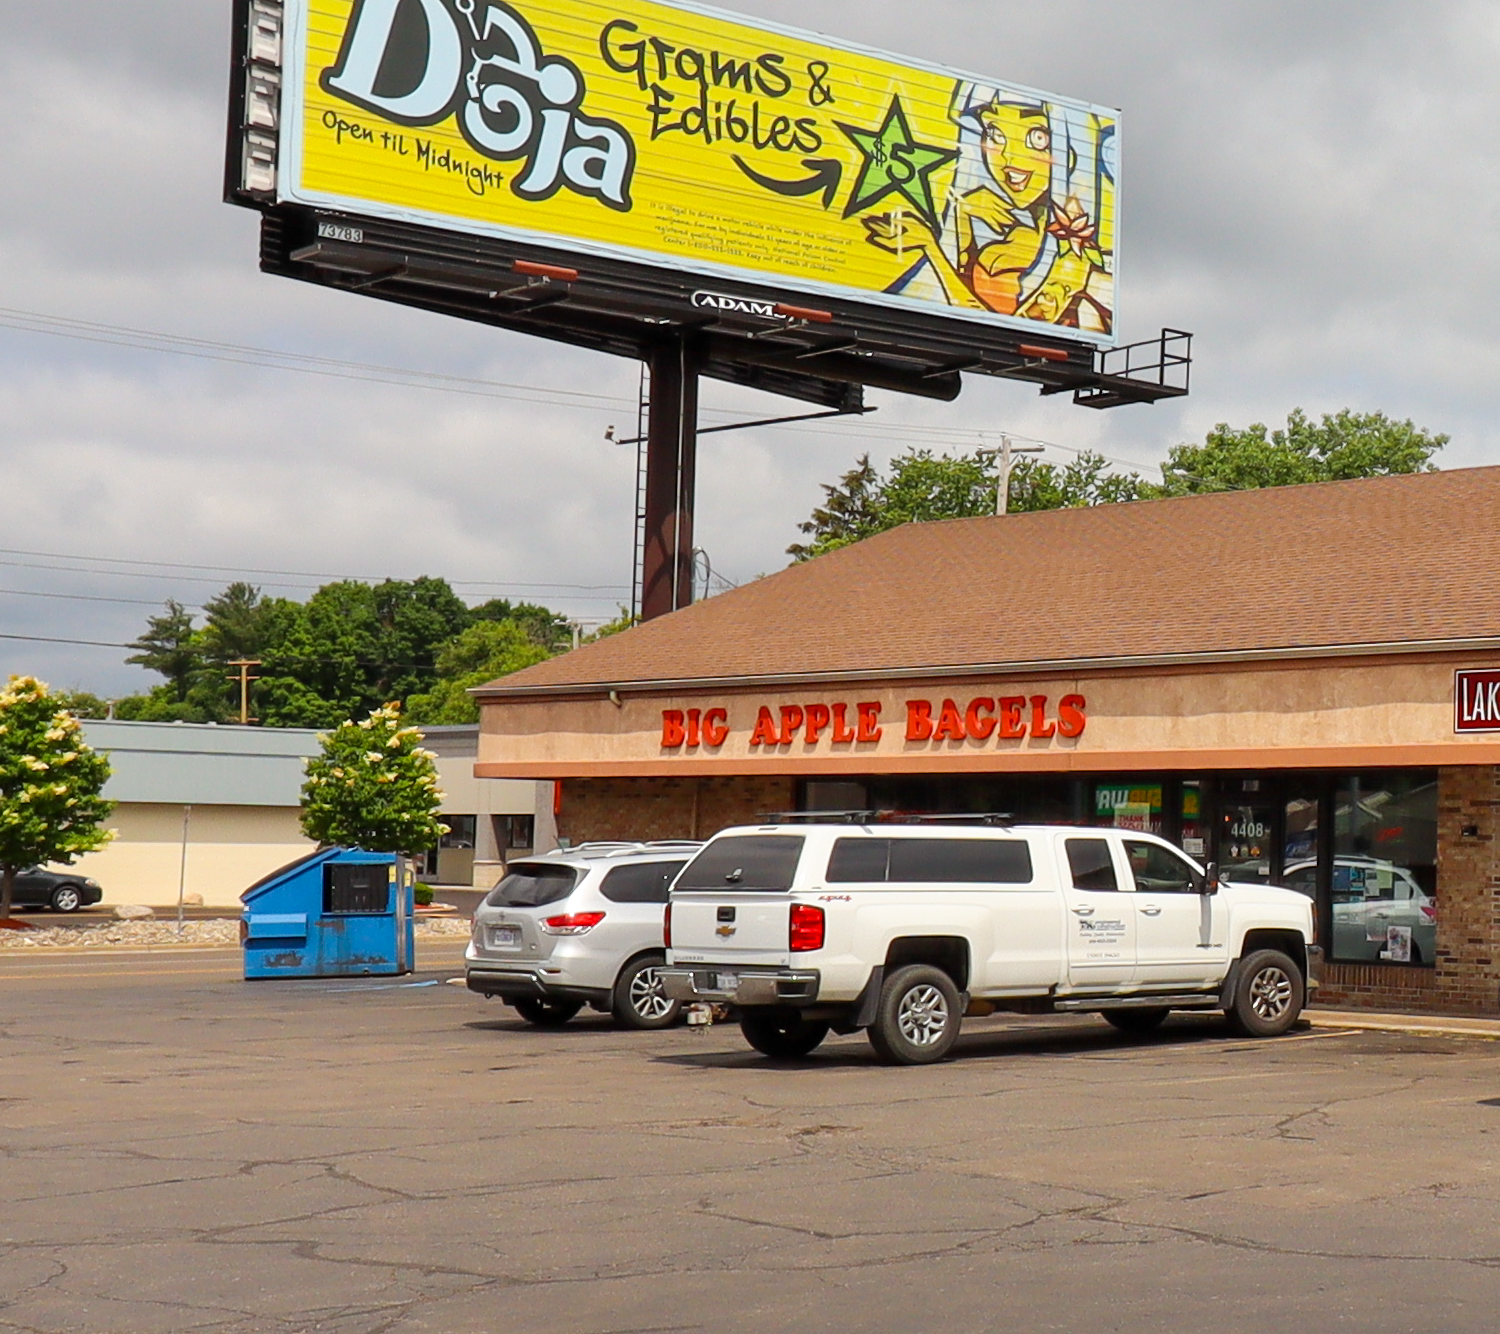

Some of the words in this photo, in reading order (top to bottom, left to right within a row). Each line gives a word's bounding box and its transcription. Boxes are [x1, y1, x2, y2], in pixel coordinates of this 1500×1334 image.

[600, 19, 791, 98] Grams
[807, 61, 835, 106] &
[646, 83, 822, 153] Edibles
[323, 110, 373, 144] Open
[381, 131, 409, 155] til
[415, 138, 504, 195] Midnight
[871, 136, 916, 183] $5
[321, 223, 361, 242] 73783
[700, 296, 787, 319] ADAM
[660, 707, 730, 748] BIG
[749, 701, 882, 746] APPLE
[904, 694, 1087, 741] BAGELS
[1231, 823, 1264, 837] 4408
